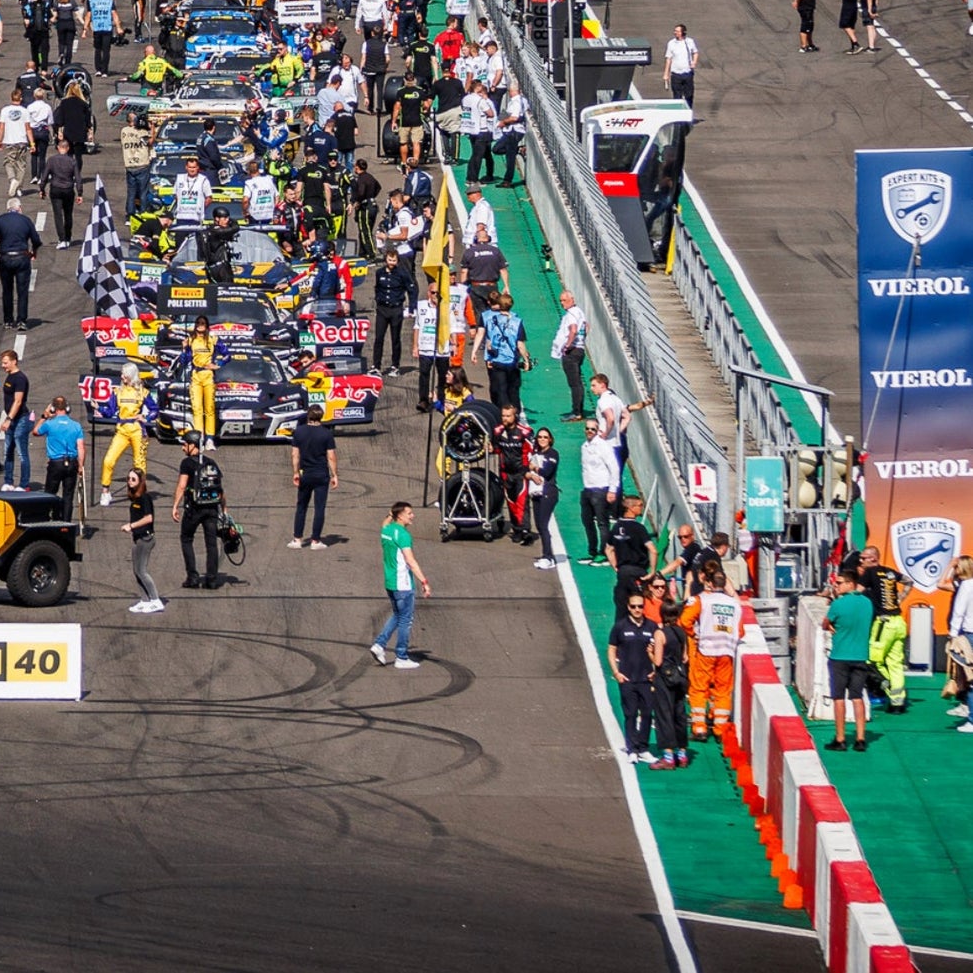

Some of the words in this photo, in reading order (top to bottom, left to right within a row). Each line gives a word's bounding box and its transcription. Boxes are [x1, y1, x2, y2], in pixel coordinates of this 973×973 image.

[888, 172, 917, 186] EXPERT
[919, 173, 938, 184] KITS
[868, 277, 970, 296] VIEROL
[167, 300, 185, 308] POLE
[186, 300, 207, 308] SETTER
[870, 369, 972, 388] VIEROL
[874, 459, 973, 479] VIEROL
[897, 520, 927, 534] EXPERT
[929, 520, 949, 531] KITS
[14, 649, 61, 674] 40
